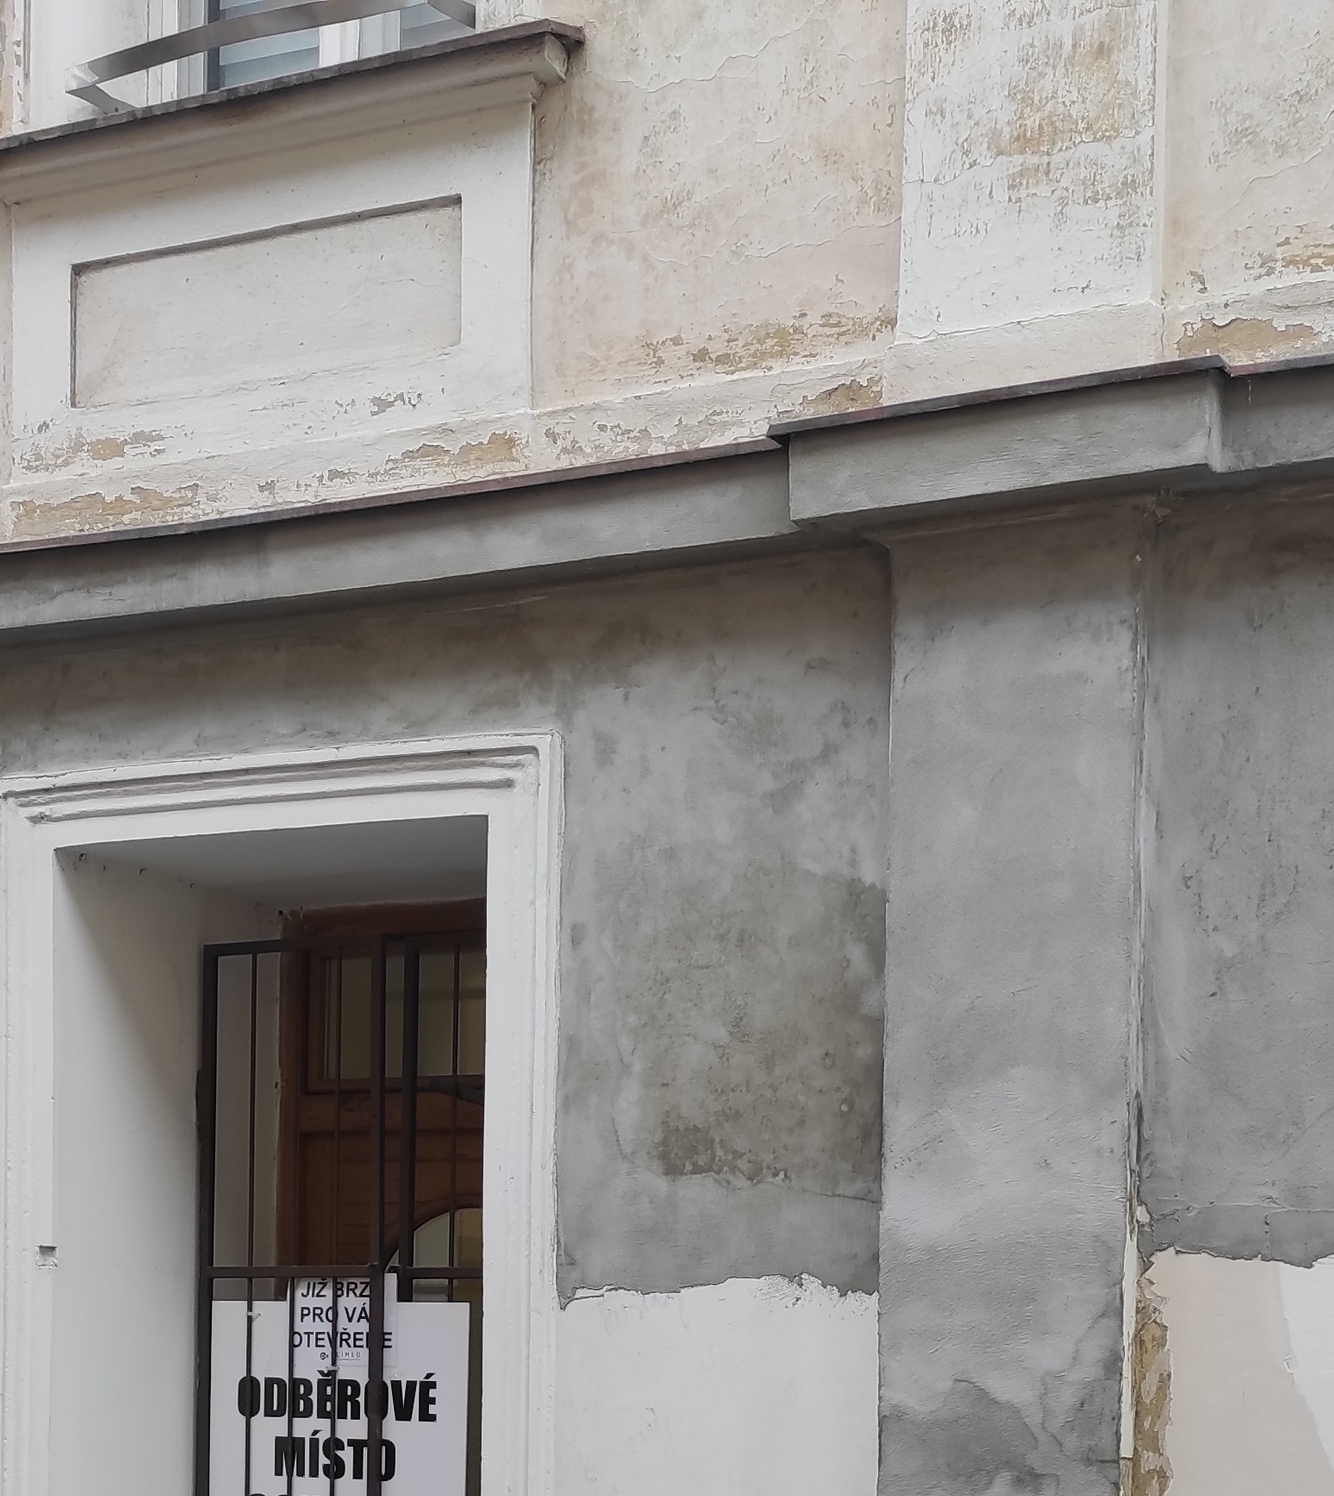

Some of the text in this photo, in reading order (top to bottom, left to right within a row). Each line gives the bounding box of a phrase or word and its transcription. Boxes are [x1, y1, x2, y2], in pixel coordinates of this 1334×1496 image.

[301, 1278, 373, 1298] JIŽ BRZ
[300, 1302, 372, 1323] PRO VÁ
[292, 1327, 393, 1349] OTEVŘEE
[274, 1429, 397, 1482] MÍSTO
